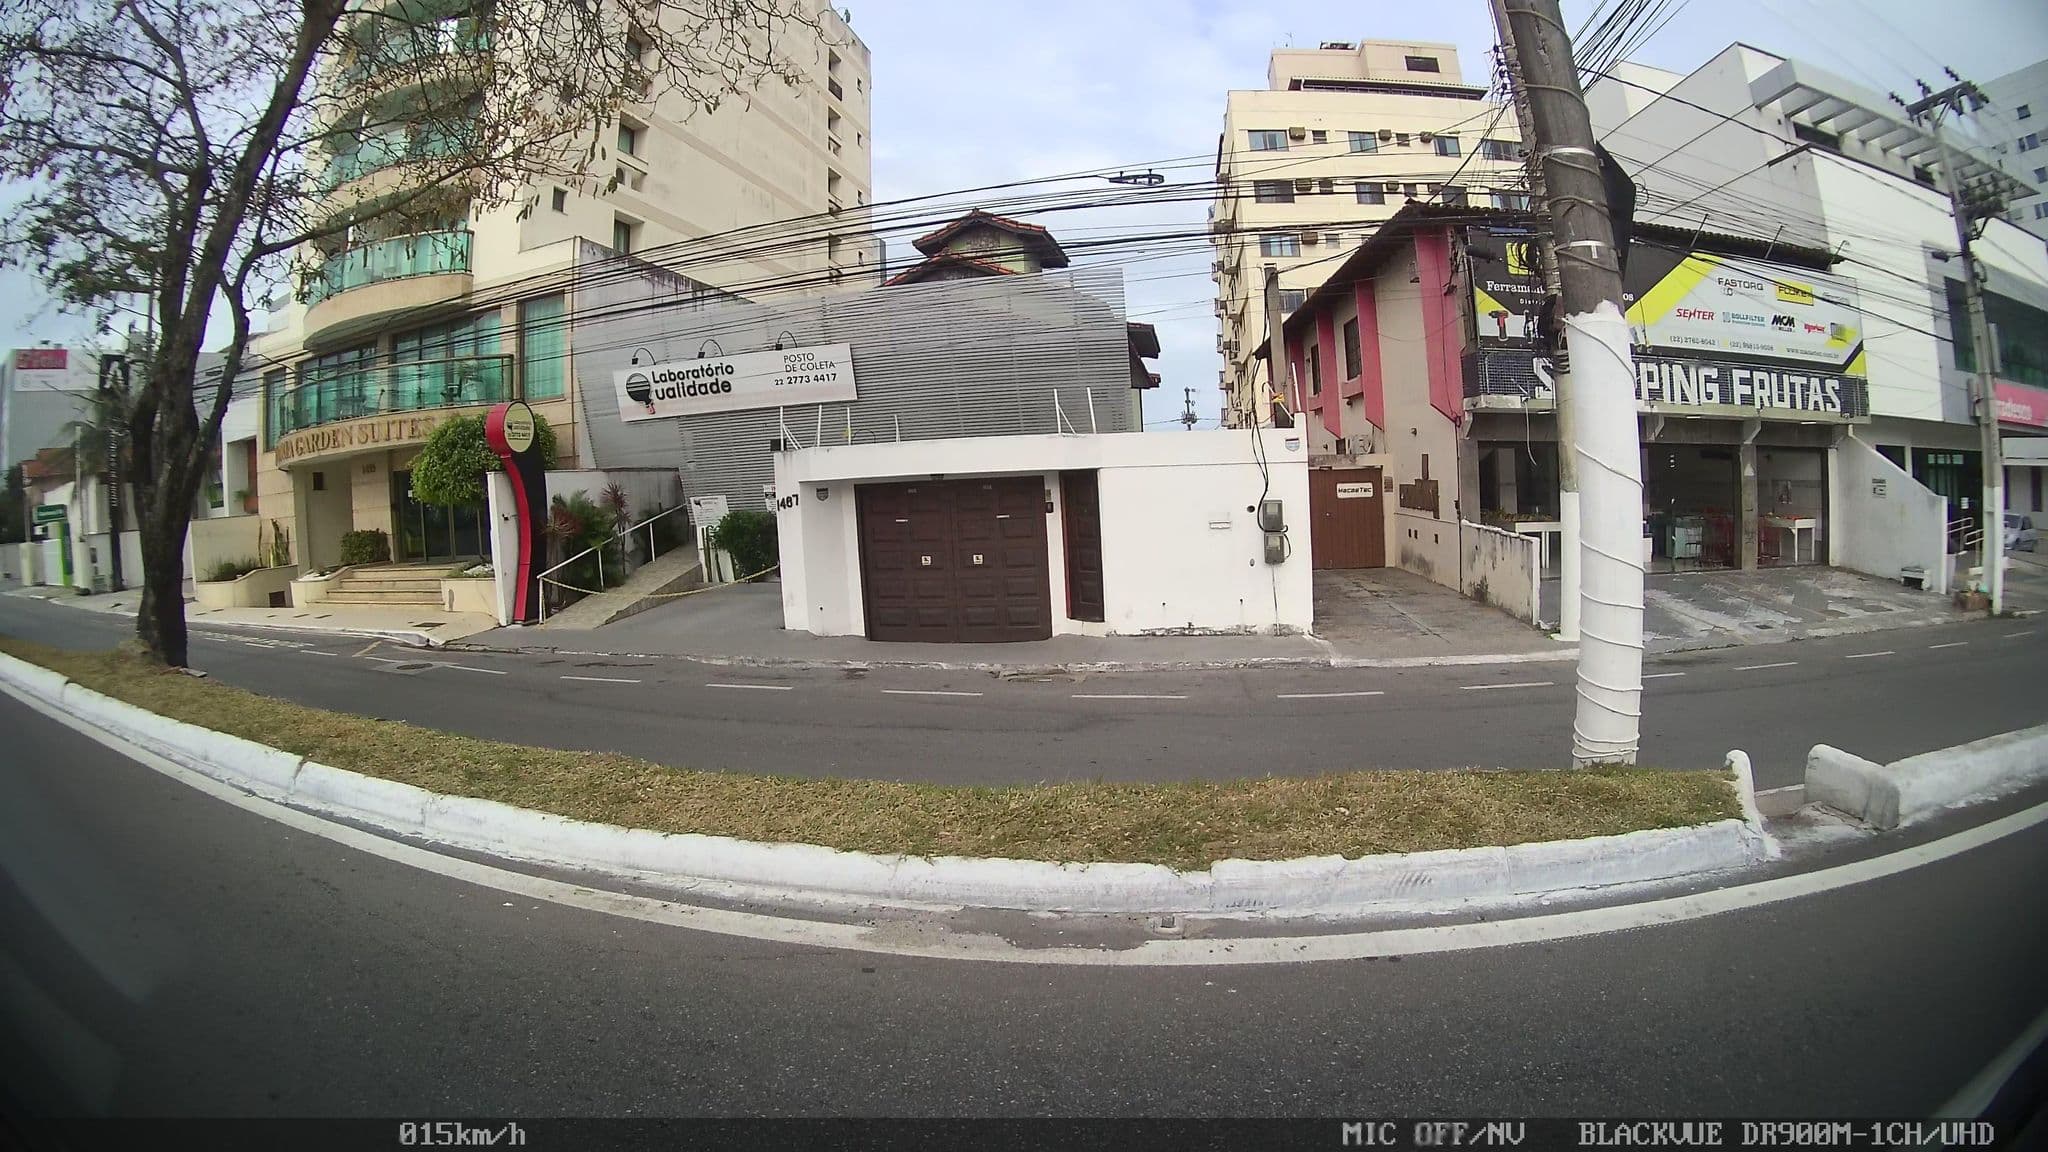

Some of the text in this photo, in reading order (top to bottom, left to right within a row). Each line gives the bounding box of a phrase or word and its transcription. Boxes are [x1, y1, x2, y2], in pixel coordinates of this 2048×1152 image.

[1771, 314, 1795, 328] MCM
[784, 352, 815, 363] POSTO
[652, 363, 734, 384] Laboratório
[785, 361, 836, 373] DE COLETA
[787, 376, 811, 385] 2773
[814, 373, 837, 382] 4417
[1732, 368, 1841, 413] FRUTAS
[295, 424, 353, 457] GARDEN
[358, 416, 435, 445] SUITES
[777, 494, 799, 511] 1487
